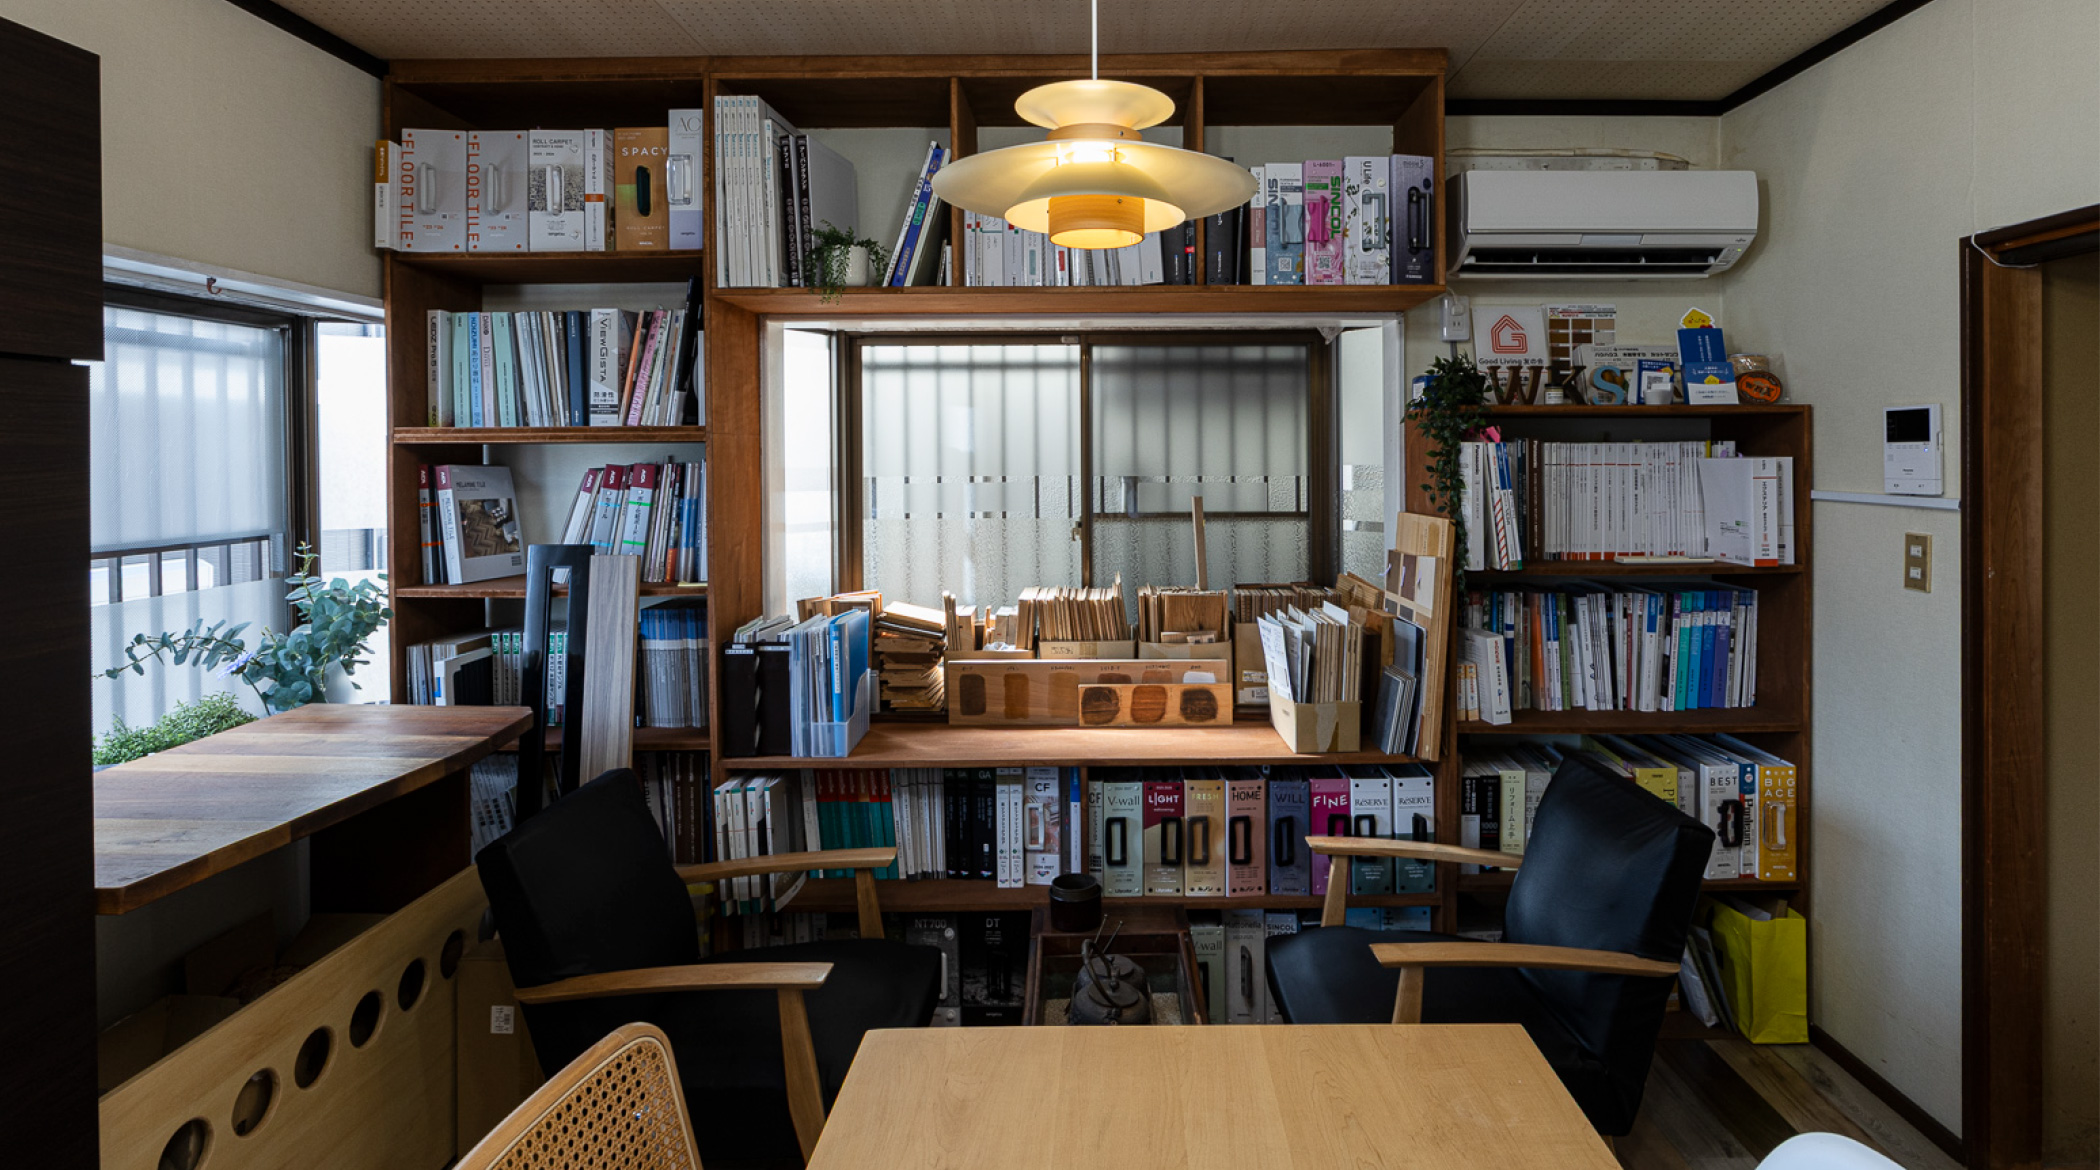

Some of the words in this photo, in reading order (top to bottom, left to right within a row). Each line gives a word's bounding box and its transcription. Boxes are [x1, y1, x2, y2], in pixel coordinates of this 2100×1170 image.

[621, 147, 668, 157] SPACY
[400, 140, 414, 197] FLOOR
[467, 142, 480, 199] FLOOR
[1268, 178, 1279, 237] SINCOL
[1330, 176, 1341, 240] SINCOL
[400, 202, 414, 241] TILE
[467, 204, 480, 242] TILE
[1478, 357, 1498, 365] Good
[1500, 357, 1522, 366] Living
[978, 770, 991, 779] GA
[1035, 782, 1051, 792] CF
[1710, 776, 1738, 787] BEST
[1764, 778, 1796, 787] BIG
[1148, 792, 1179, 806] LIGHT
[1232, 790, 1261, 801] HOME
[1274, 793, 1305, 804] WILL
[1764, 789, 1795, 798] ACE
[1108, 795, 1140, 806] V-wall
[1312, 794, 1348, 809] FINE
[1508, 787, 1516, 839] リフォーム上手
[914, 918, 947, 929] NT700
[985, 918, 1001, 928] DT
